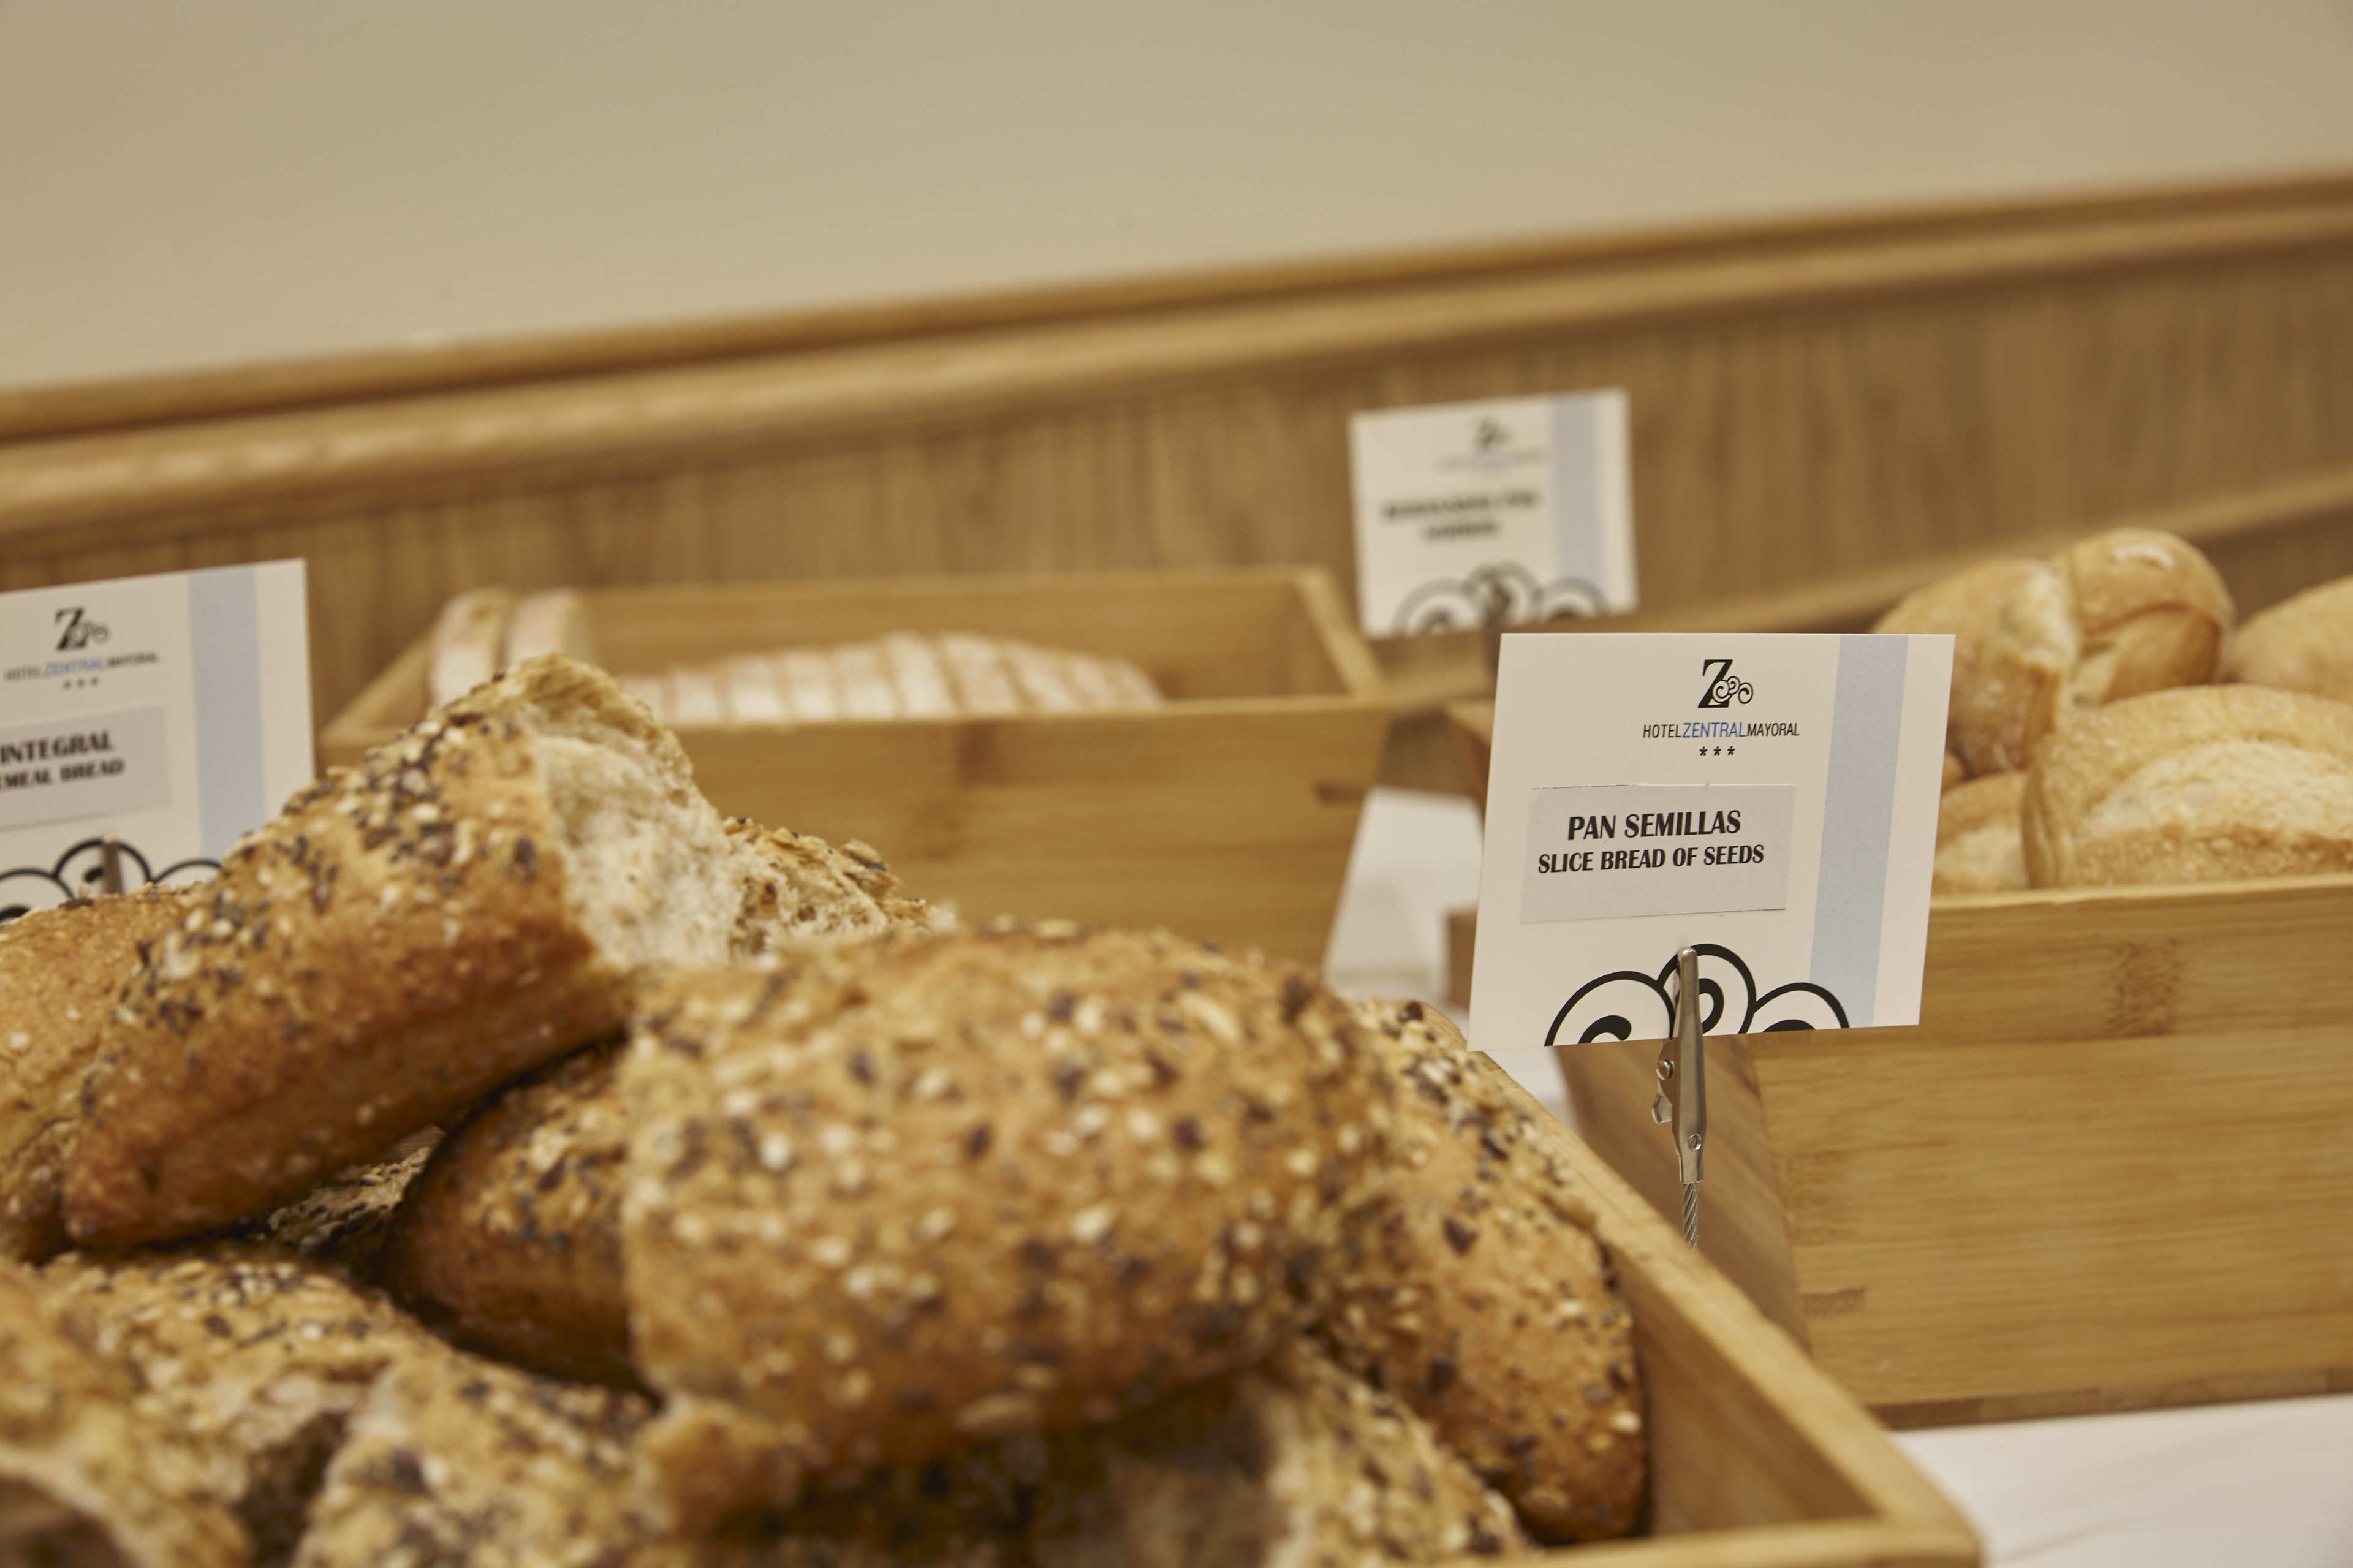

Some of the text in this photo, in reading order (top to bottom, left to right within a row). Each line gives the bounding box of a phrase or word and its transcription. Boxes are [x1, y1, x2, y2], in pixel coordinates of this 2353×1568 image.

[0, 730, 114, 763] INTEGRAL
[59, 758, 125, 782] BREAD
[1567, 809, 1741, 841] PAN SEMILLAS
[1538, 844, 1765, 873] SLICE BREAD OF SEEDS
